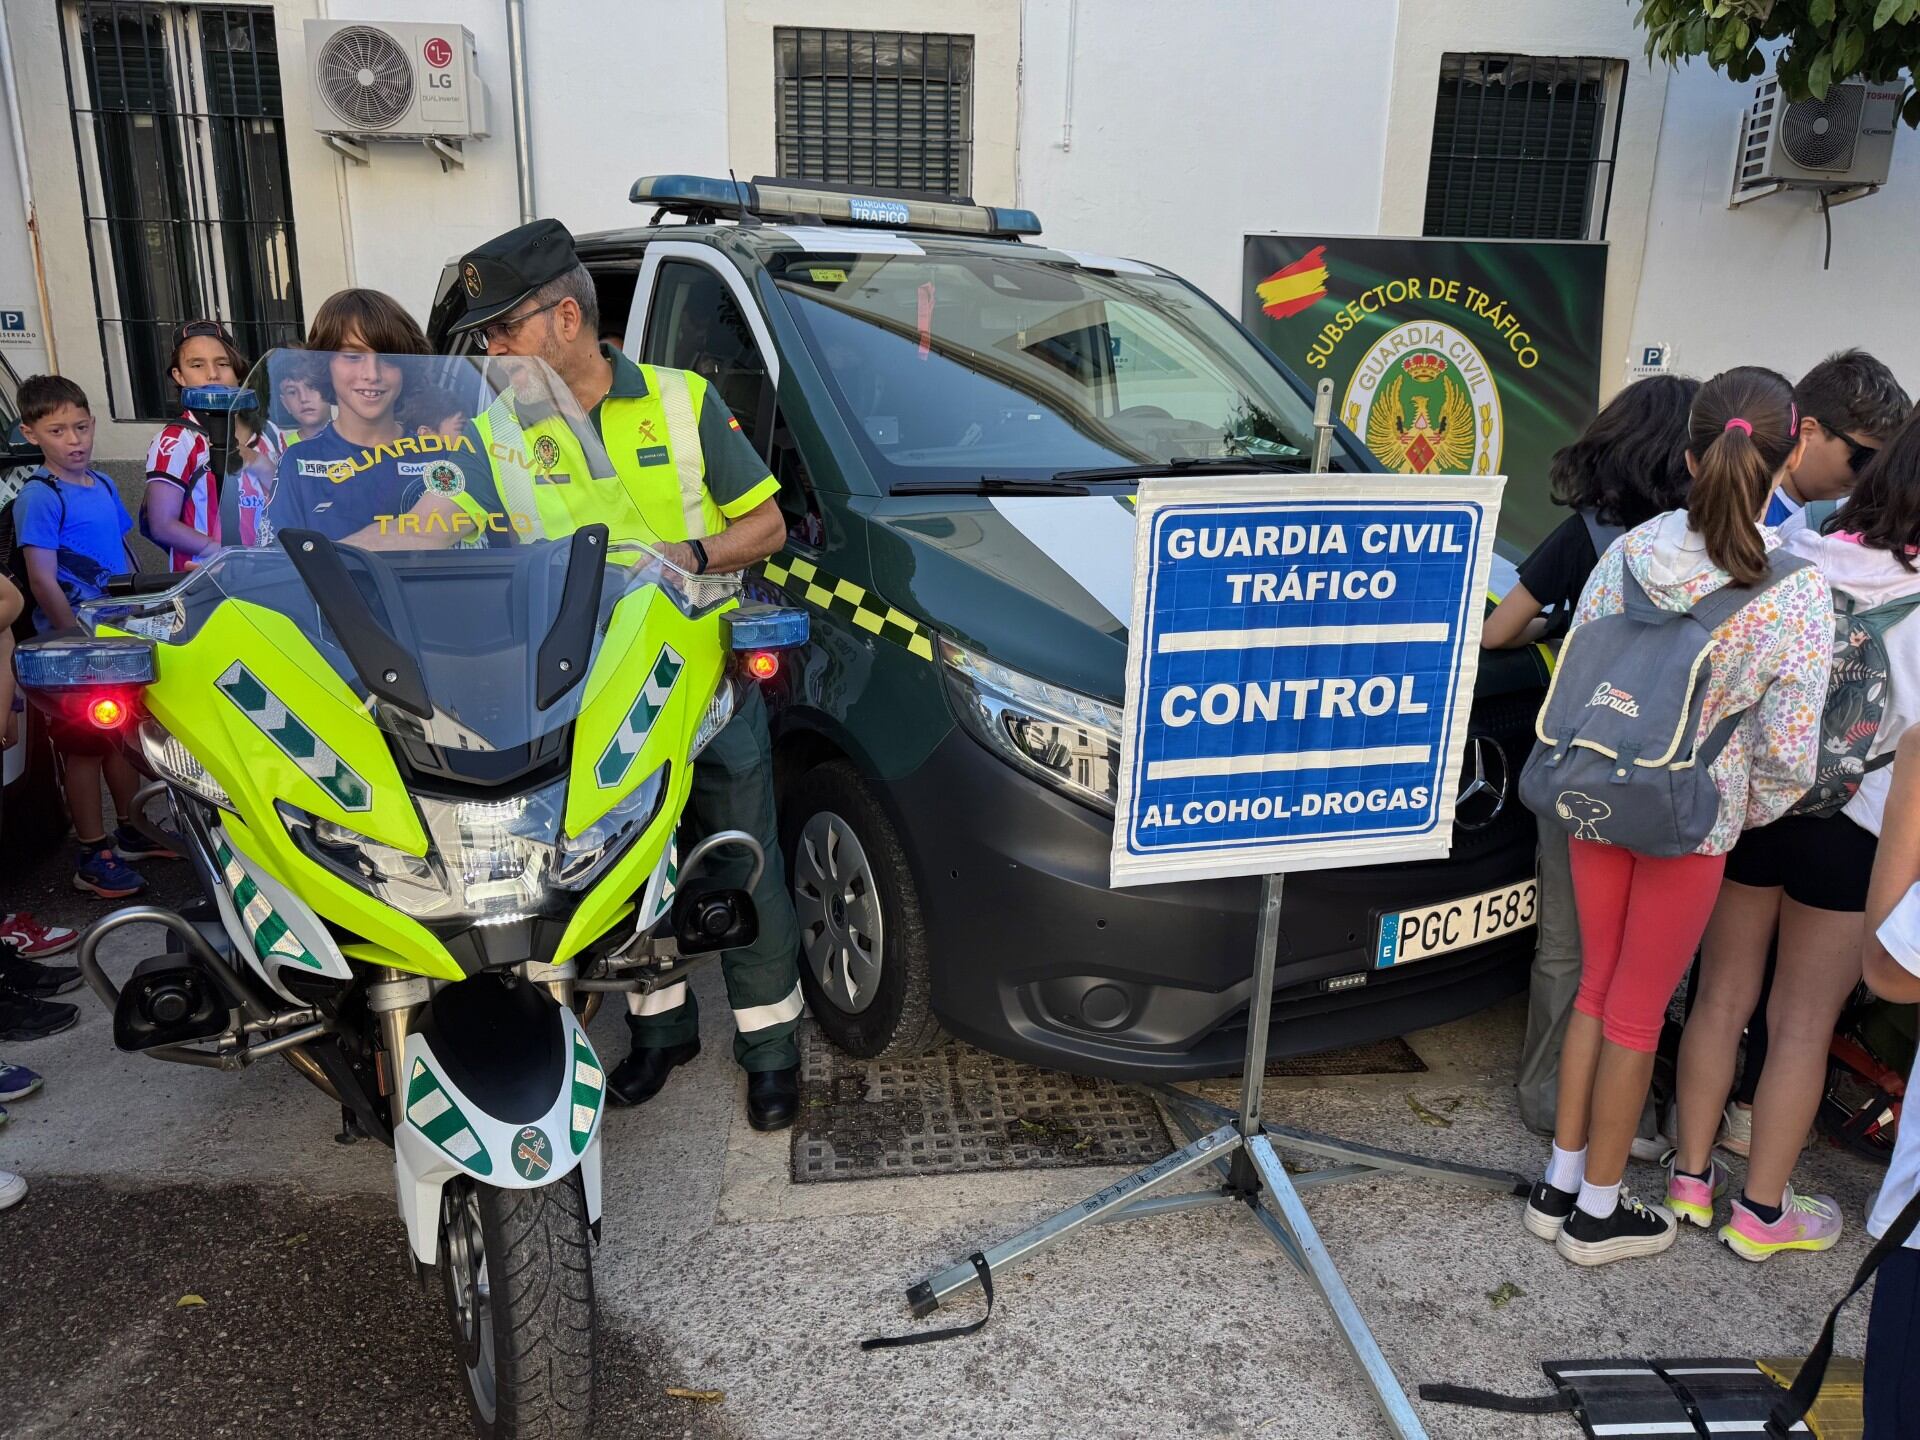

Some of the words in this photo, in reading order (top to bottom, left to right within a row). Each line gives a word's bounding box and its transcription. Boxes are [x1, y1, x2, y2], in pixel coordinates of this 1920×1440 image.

[428, 73, 452, 88] LG
[851, 199, 887, 210] GUARDIA
[887, 202, 906, 212] CIVIL
[853, 208, 907, 224] TRAFICO
[5, 313, 19, 328] P
[1306, 278, 1422, 369] SUBSECTOR
[1429, 277, 1461, 303] DE
[1464, 286, 1538, 369] TRÁFICO
[1358, 326, 1445, 392] GUARDIA
[1449, 341, 1489, 394] CIVIL
[1647, 350, 1660, 364] P
[327, 434, 477, 484] GUARDIA
[373, 507, 533, 536] TRÁFICO
[1167, 524, 1347, 560] GUARDIA
[1361, 523, 1464, 554] CIVIL
[1226, 565, 1397, 604] TRÁFICO
[1160, 675, 1429, 728] CONTROL
[1585, 681, 1640, 717] Peanuts
[1140, 786, 1430, 829] ALCOHOL-DROGAS
[1383, 945, 1392, 957] E
[1398, 906, 1462, 957] PGC
[1473, 884, 1537, 939] 1583
